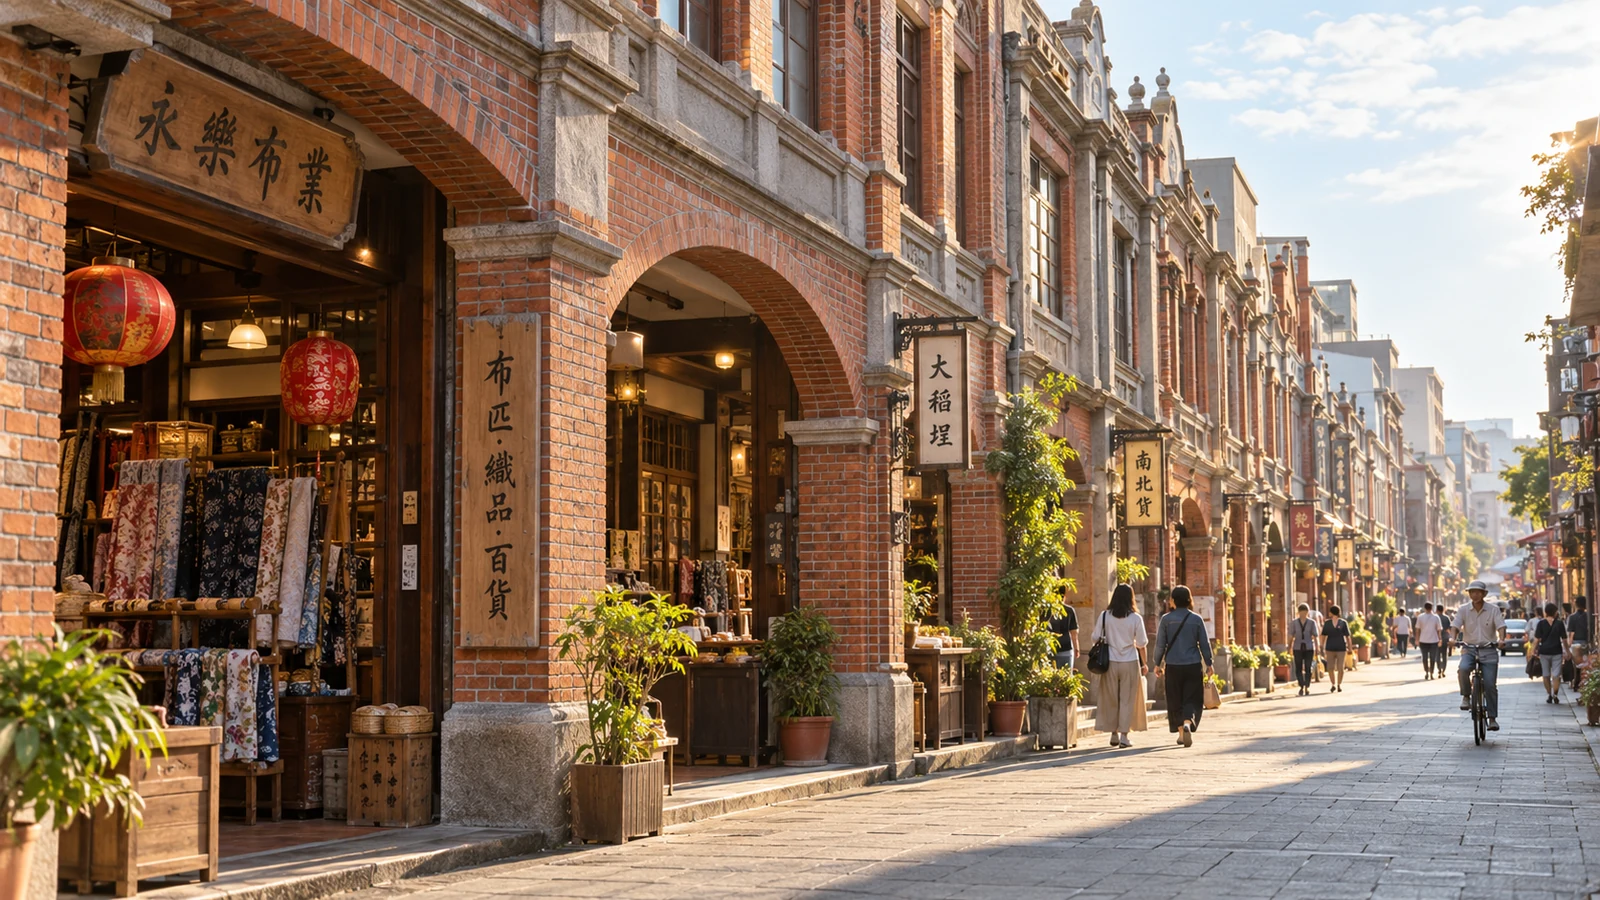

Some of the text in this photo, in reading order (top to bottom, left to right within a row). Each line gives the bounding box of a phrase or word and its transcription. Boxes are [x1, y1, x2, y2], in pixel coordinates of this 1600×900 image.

[135, 81, 332, 214] 永樂布業
[928, 354, 953, 447] 大稻埕
[1135, 450, 1153, 517] 南北貨
